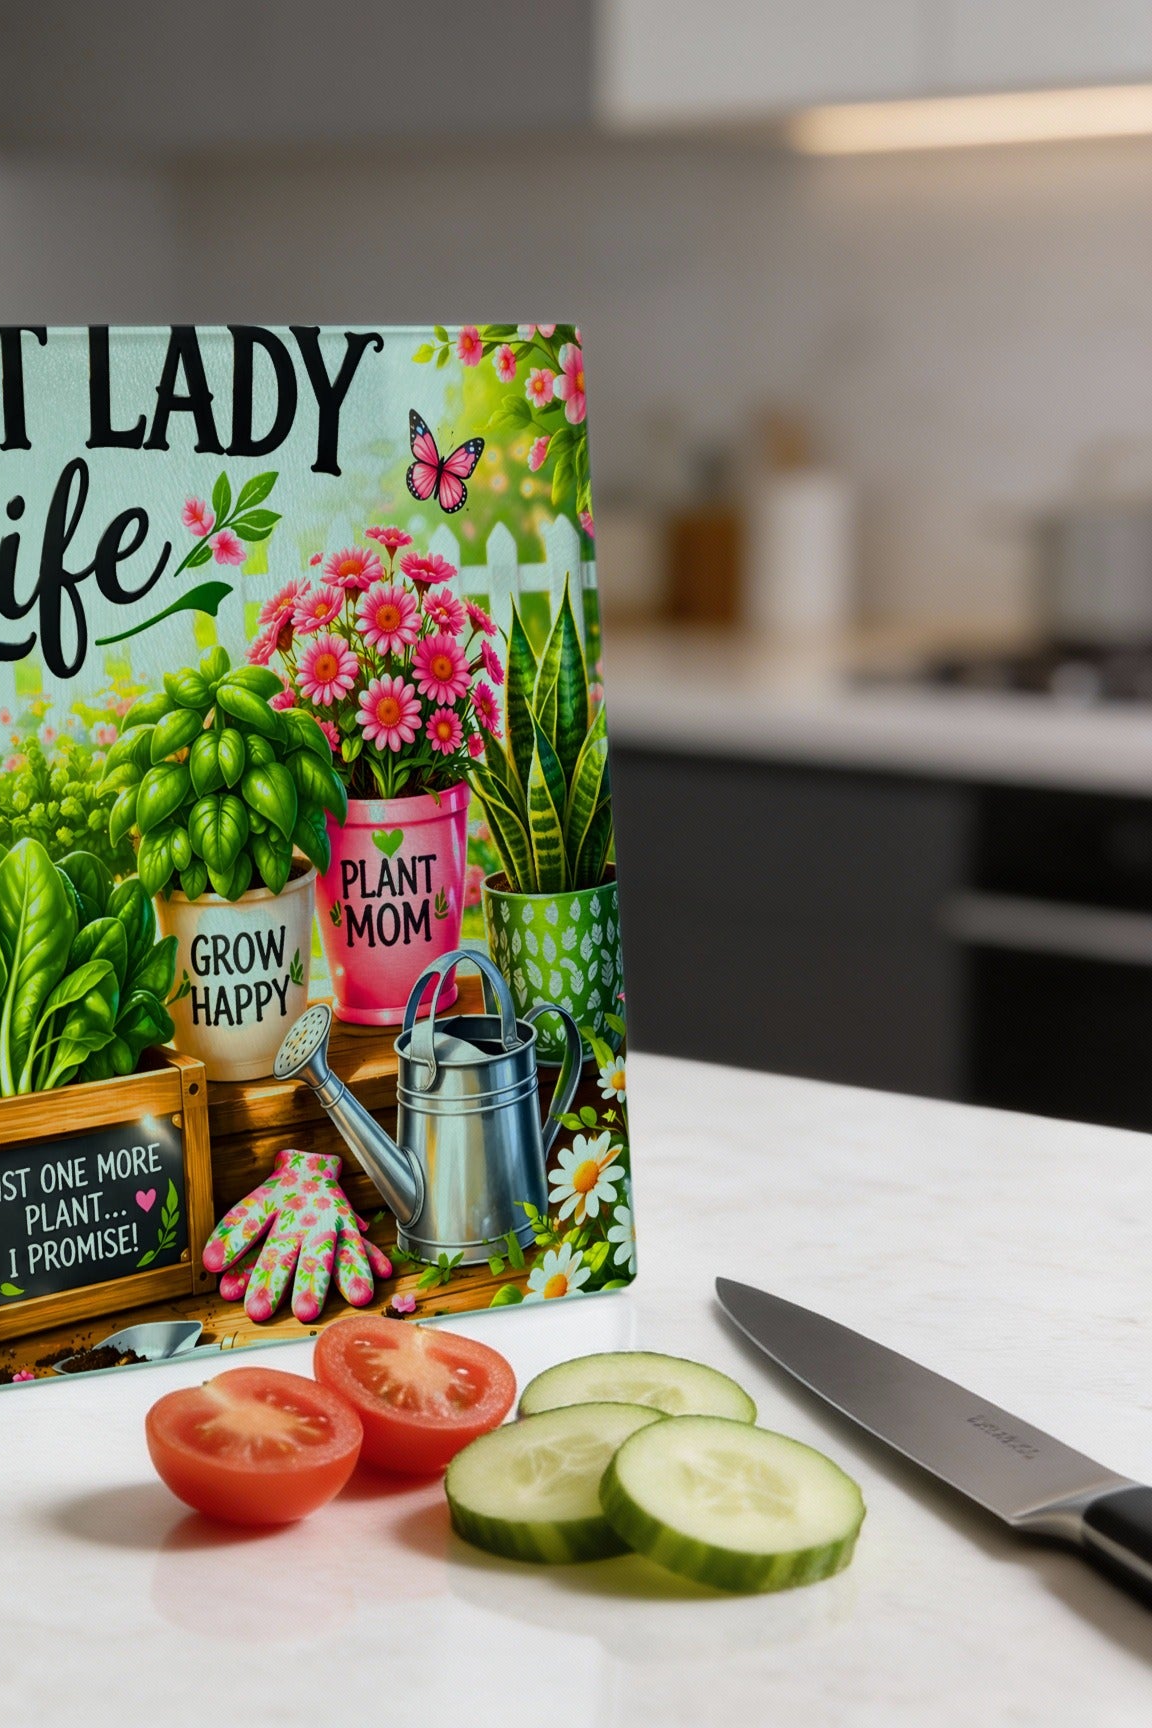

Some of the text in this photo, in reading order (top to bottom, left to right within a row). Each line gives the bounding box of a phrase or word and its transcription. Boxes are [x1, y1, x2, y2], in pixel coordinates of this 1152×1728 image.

[85, 325, 384, 477] LADY
[340, 854, 437, 900] PLANT
[344, 899, 433, 948] MOM
[190, 925, 286, 977] GROW
[190, 974, 291, 1027] HAPPY
[40, 1157, 89, 1194] ONE
[97, 1142, 163, 1184] MORE
[25, 1191, 127, 1236] PLANT...
[9, 1222, 140, 1279] I PROMISE!
